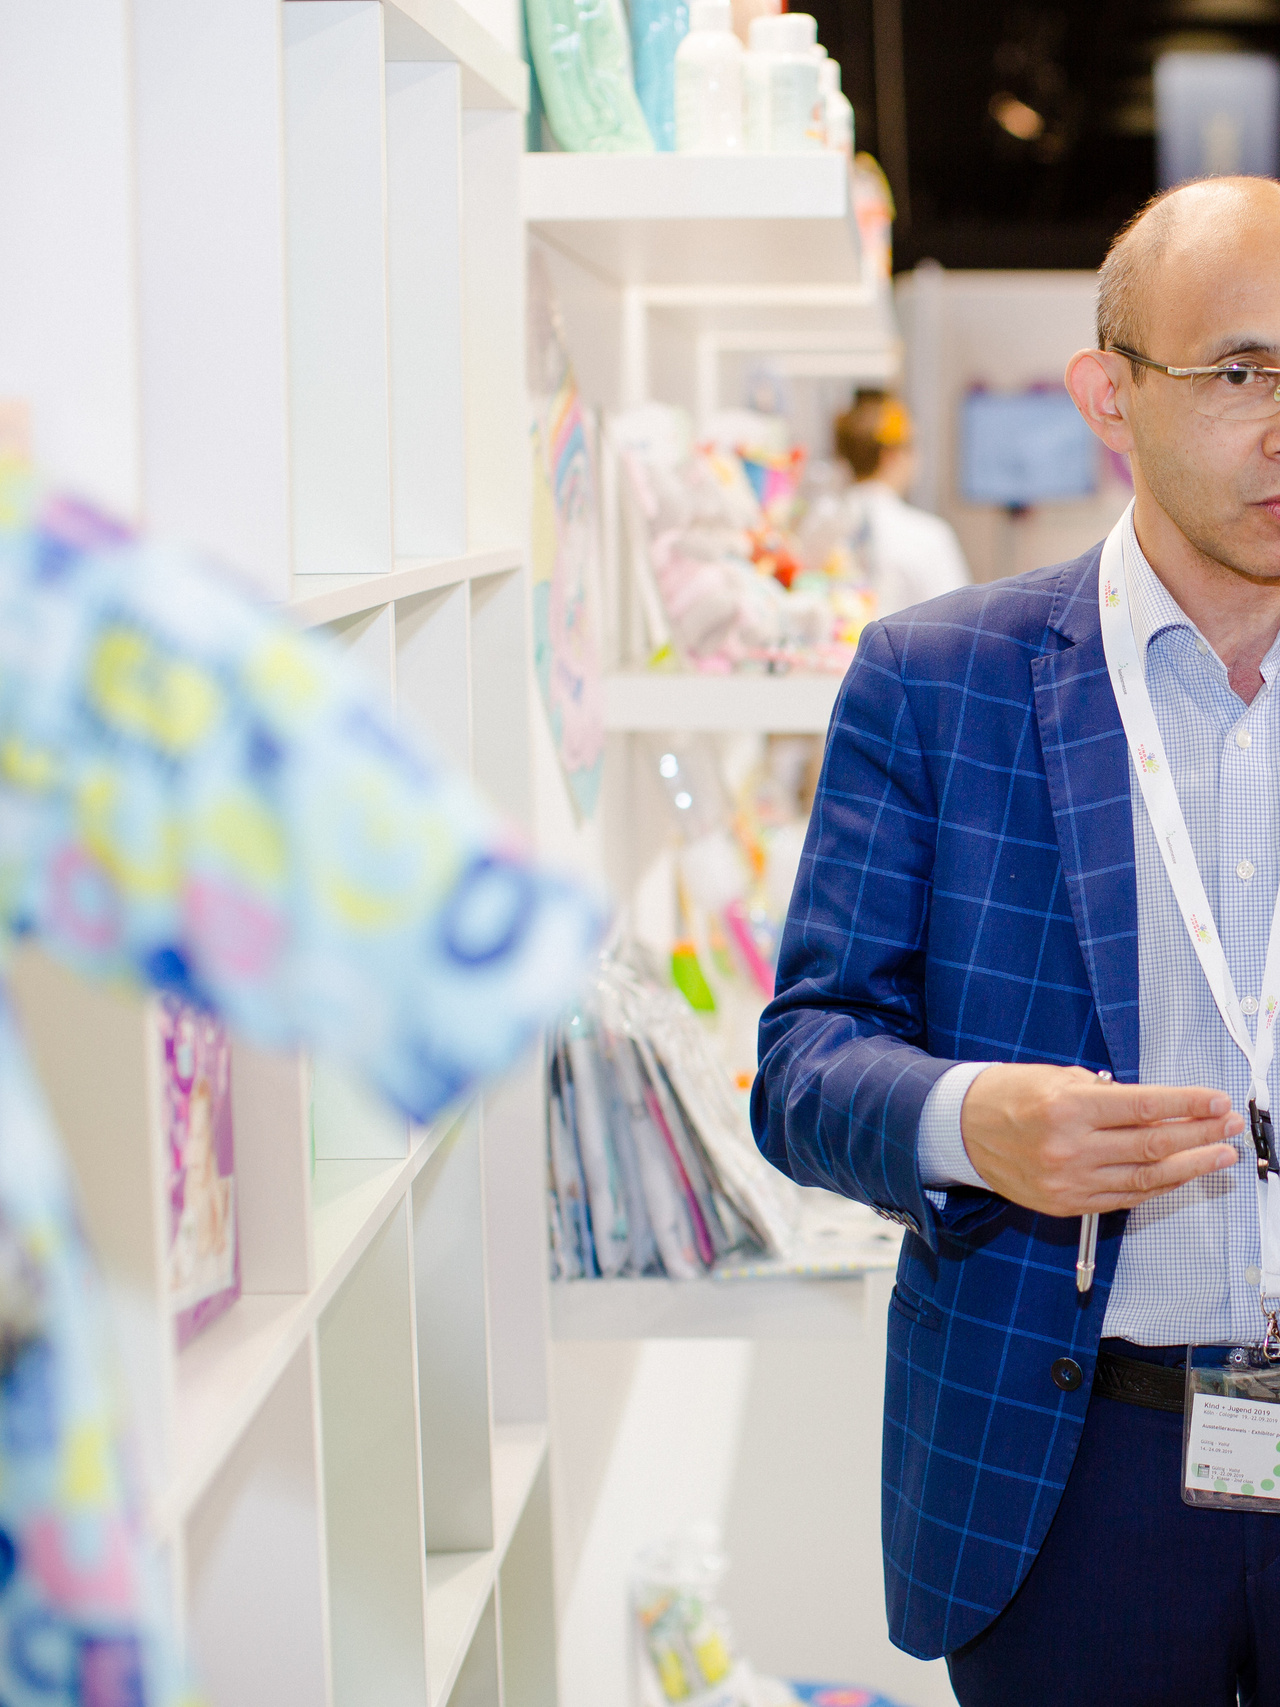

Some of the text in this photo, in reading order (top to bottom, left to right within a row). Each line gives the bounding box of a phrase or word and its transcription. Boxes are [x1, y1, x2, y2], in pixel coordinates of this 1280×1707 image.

[1204, 1402, 1219, 1410] Kind
[1227, 1405, 1252, 1414] Jugend
[1253, 1408, 1271, 1416] 2019
[1218, 1411, 1239, 1419] Cologne
[1251, 1429, 1275, 1437] Exhibitor
